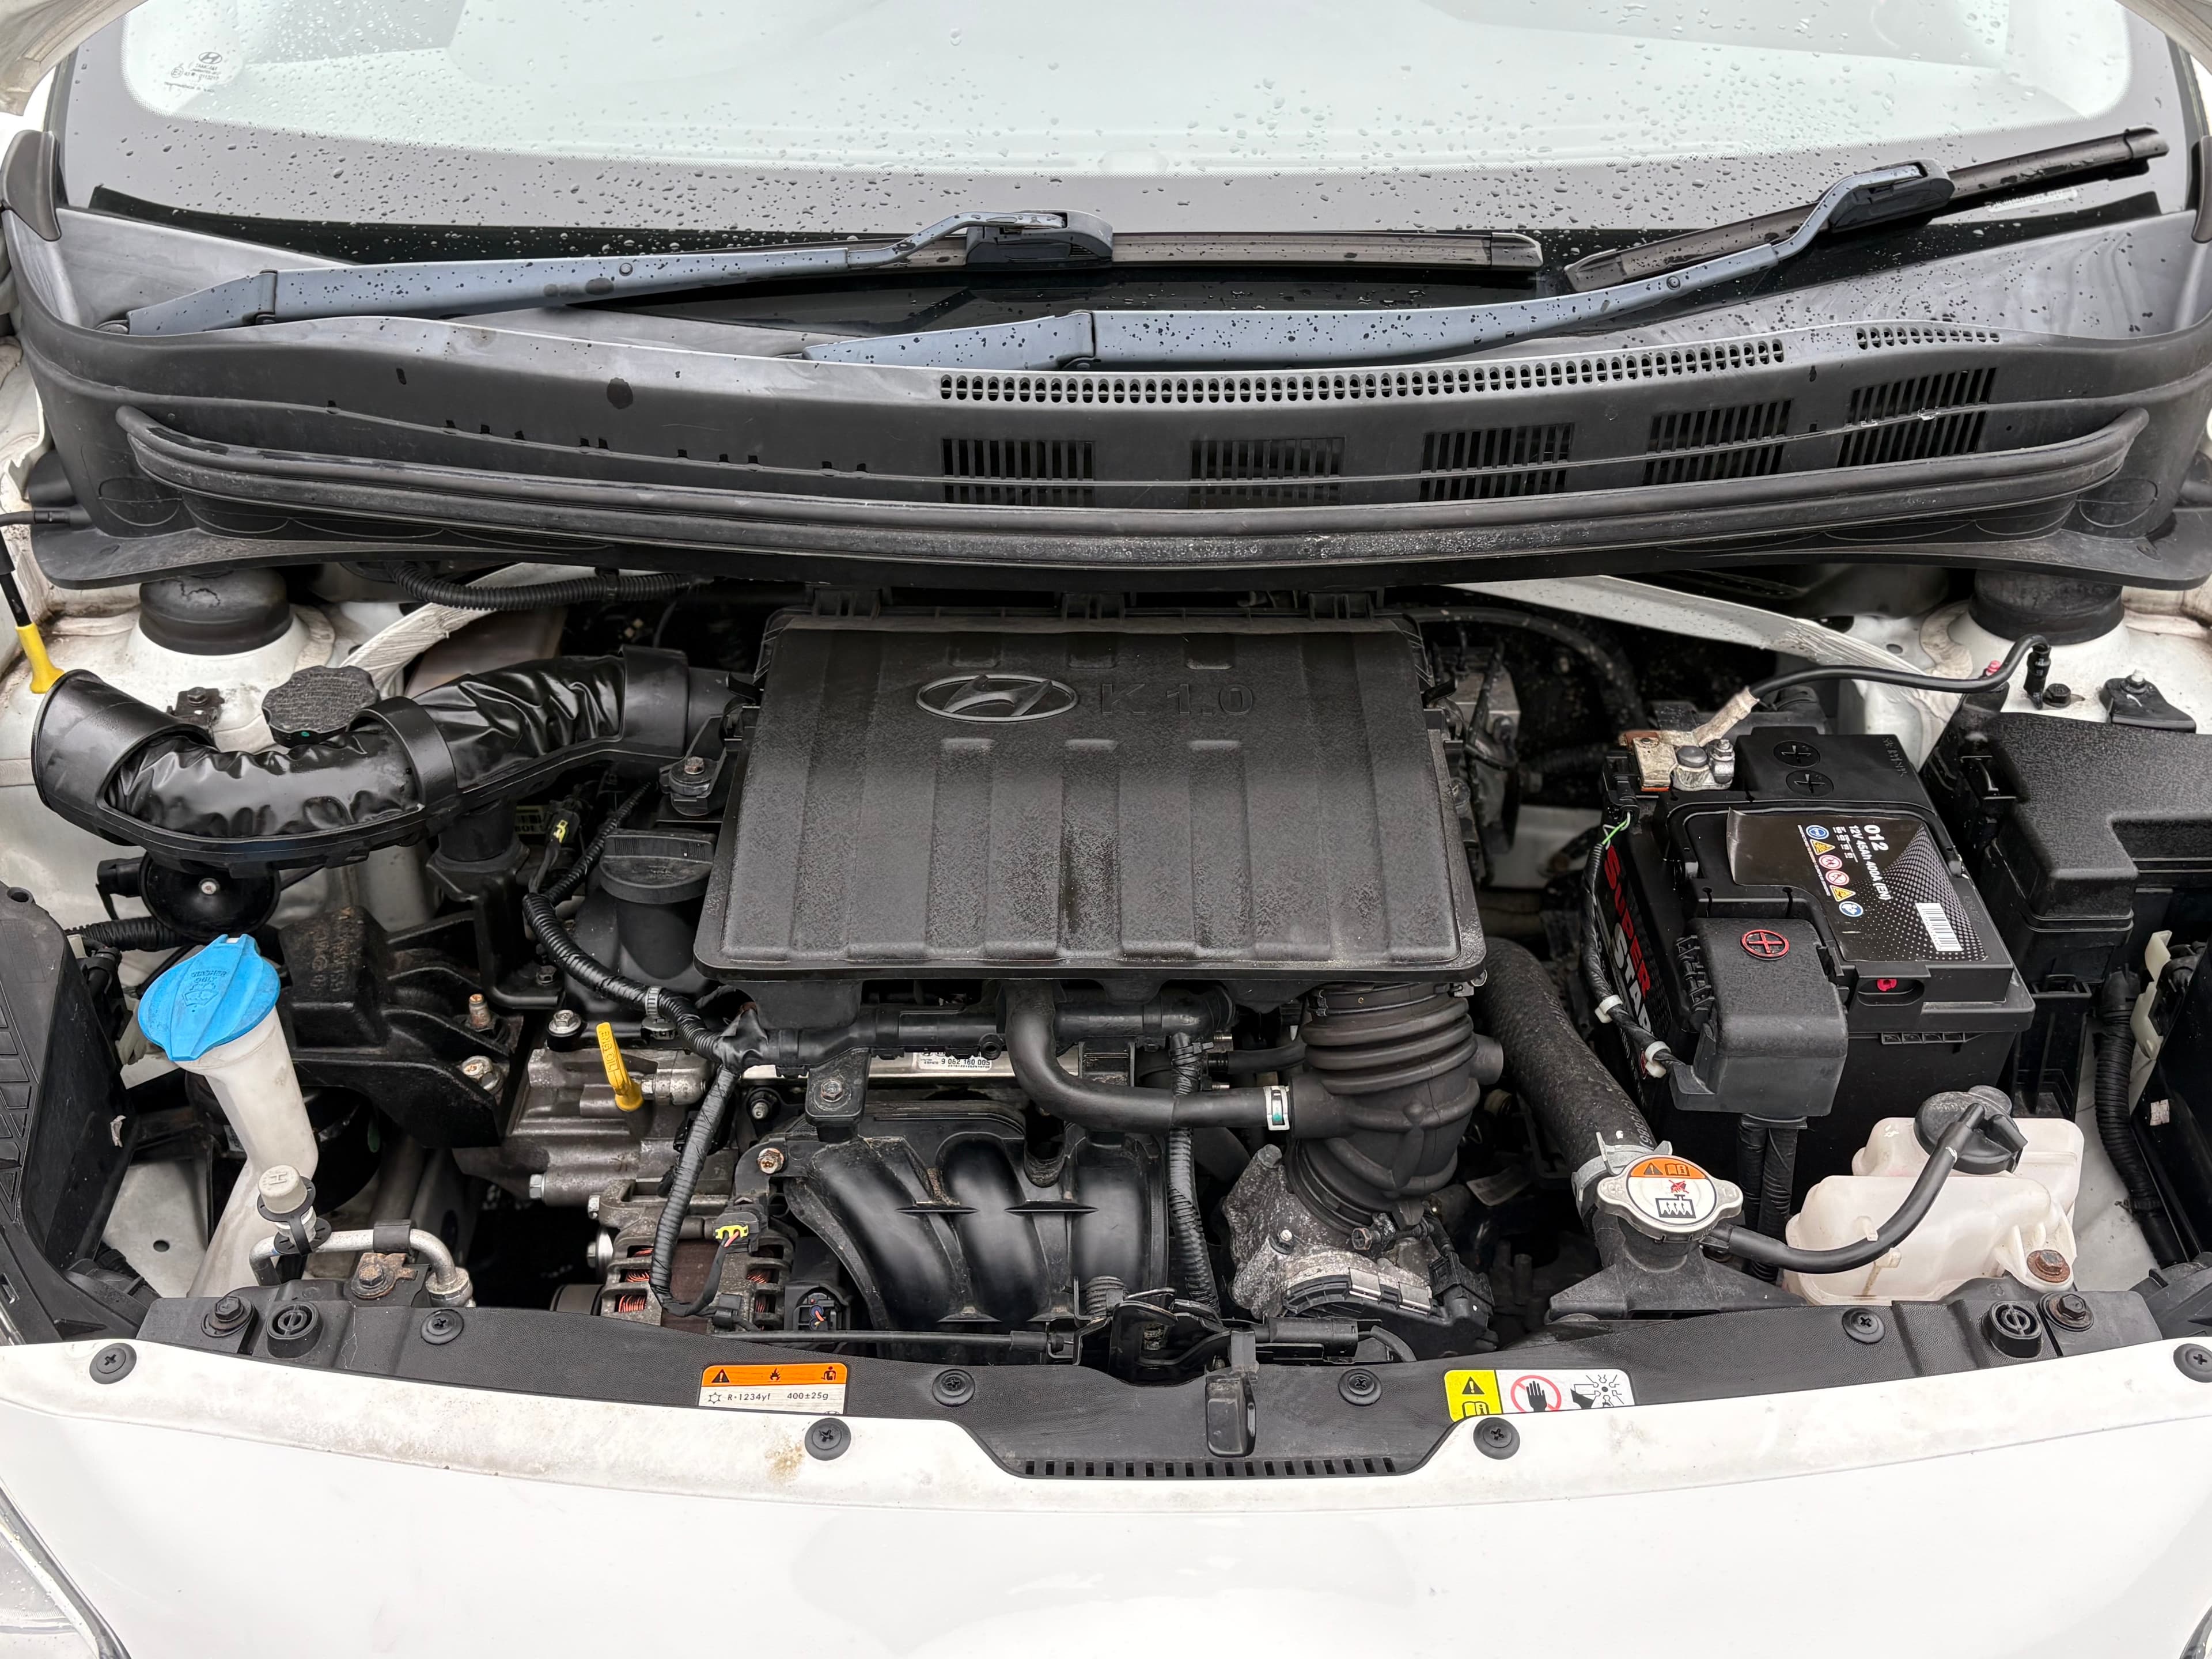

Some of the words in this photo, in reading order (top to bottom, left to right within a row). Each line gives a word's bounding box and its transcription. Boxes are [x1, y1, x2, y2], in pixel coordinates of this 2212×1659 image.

[1101, 683, 1146, 715] K
[1166, 683, 1253, 715] 1.0
[1849, 825, 1863, 839] 12V
[1864, 824, 1889, 851] 012
[1856, 840, 1873, 860] 45Ah
[1866, 861, 1883, 881] 400A
[1873, 882, 1893, 900] (EN)
[1604, 846, 1651, 999] SUPER
[1613, 922, 1655, 1036] STAR
[599, 1031, 612, 1051] ENG
[605, 1054, 616, 1070] OIL
[269, 1171, 287, 1185] H
[787, 1392, 829, 1400] 400±25g
